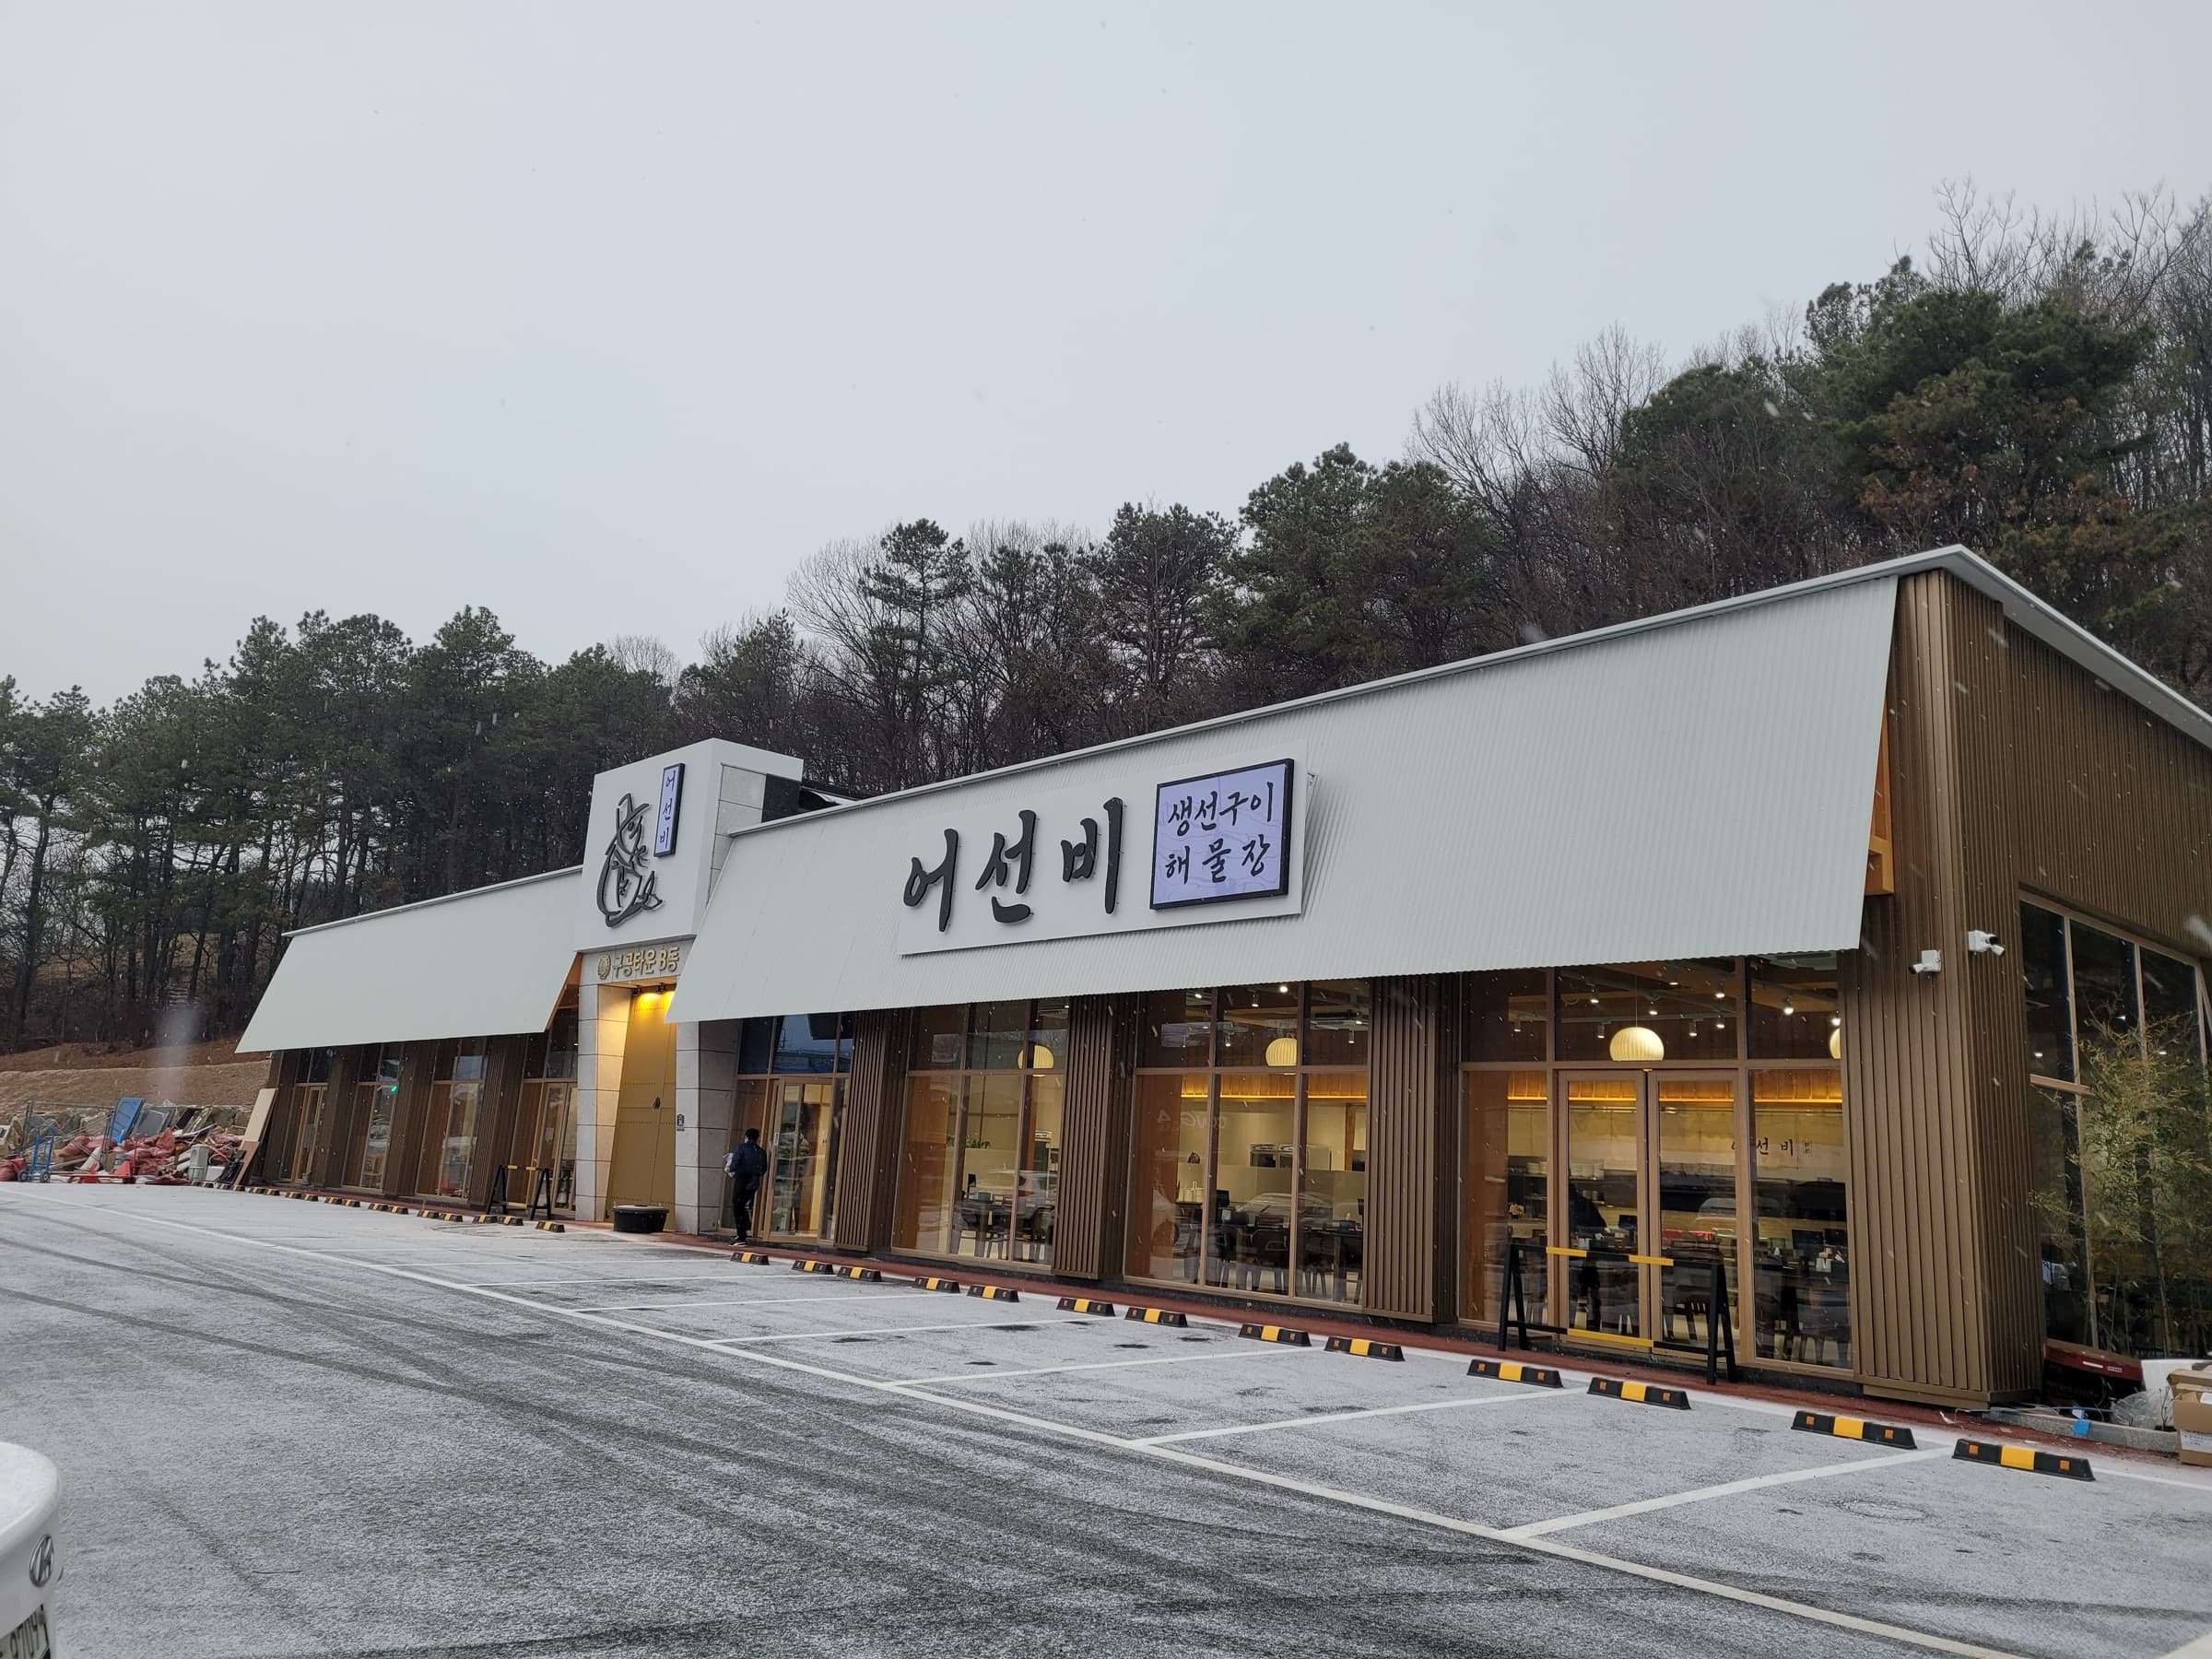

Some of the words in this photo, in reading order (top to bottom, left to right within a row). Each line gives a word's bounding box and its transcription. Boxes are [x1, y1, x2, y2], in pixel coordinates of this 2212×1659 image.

[659, 769, 677, 850] 어선비
[1167, 781, 1274, 837] 생선구이
[902, 796, 1124, 933] 어선비
[1165, 833, 1271, 885] 해물장
[612, 949, 657, 979] 구공타운
[659, 946, 679, 972] B동
